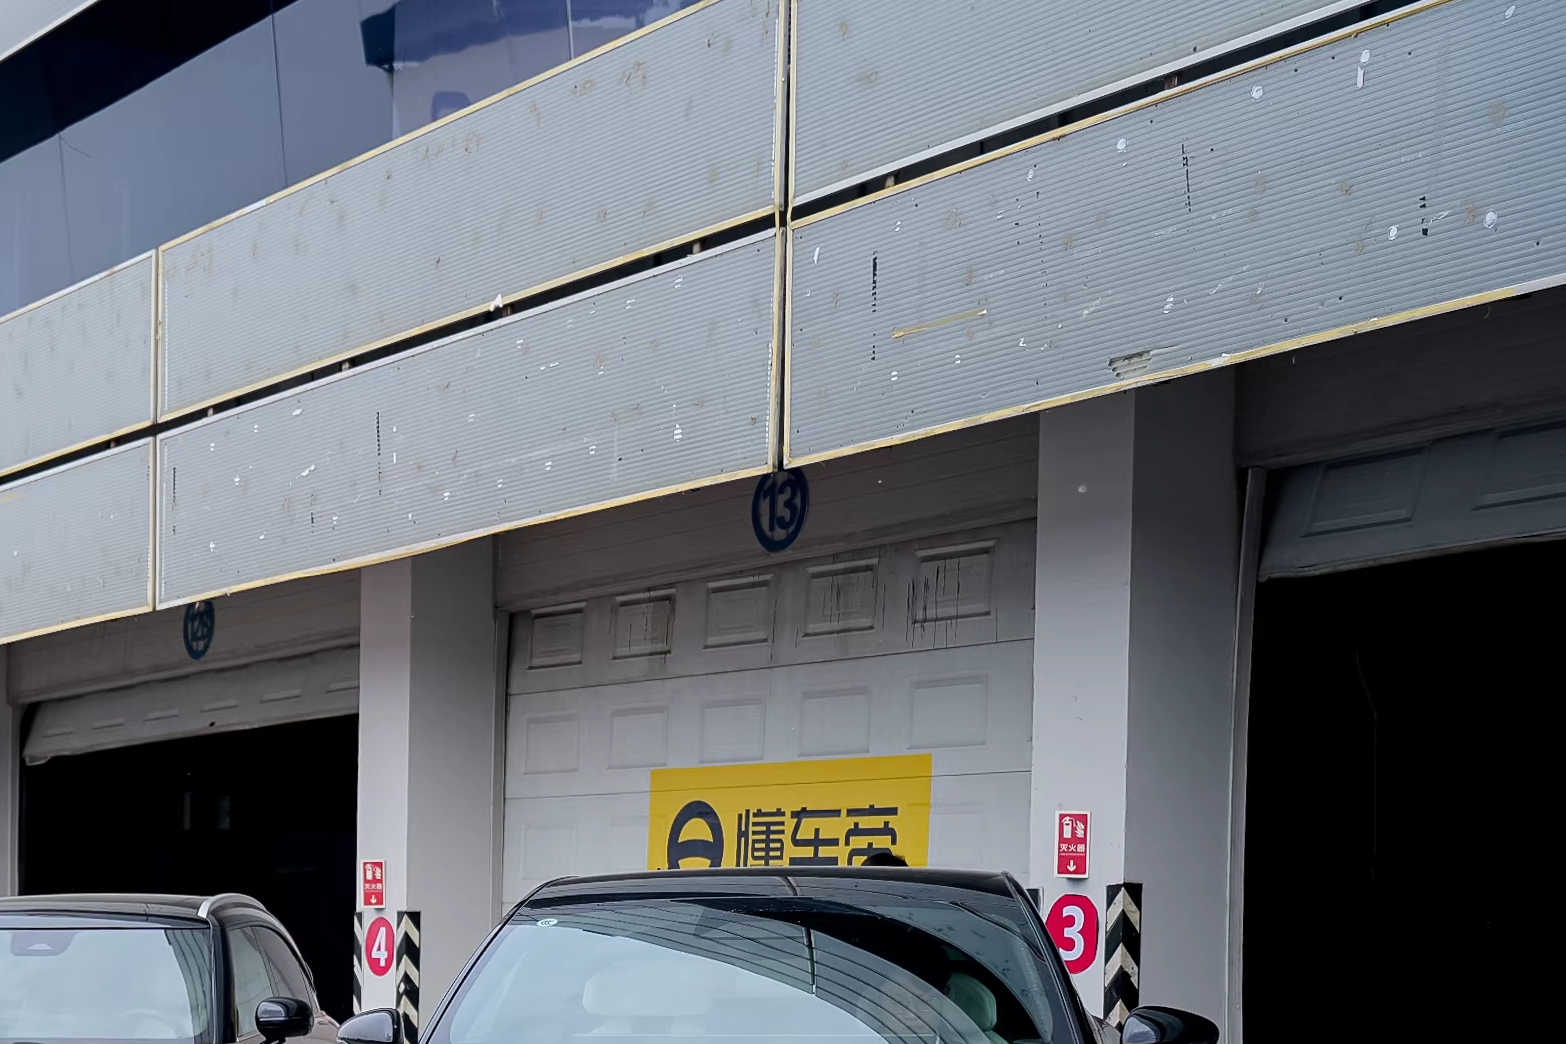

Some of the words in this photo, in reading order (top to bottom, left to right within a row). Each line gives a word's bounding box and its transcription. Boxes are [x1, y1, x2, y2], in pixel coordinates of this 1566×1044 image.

[762, 479, 798, 532] 13
[371, 926, 388, 967] 4
[1058, 905, 1085, 961] 3
